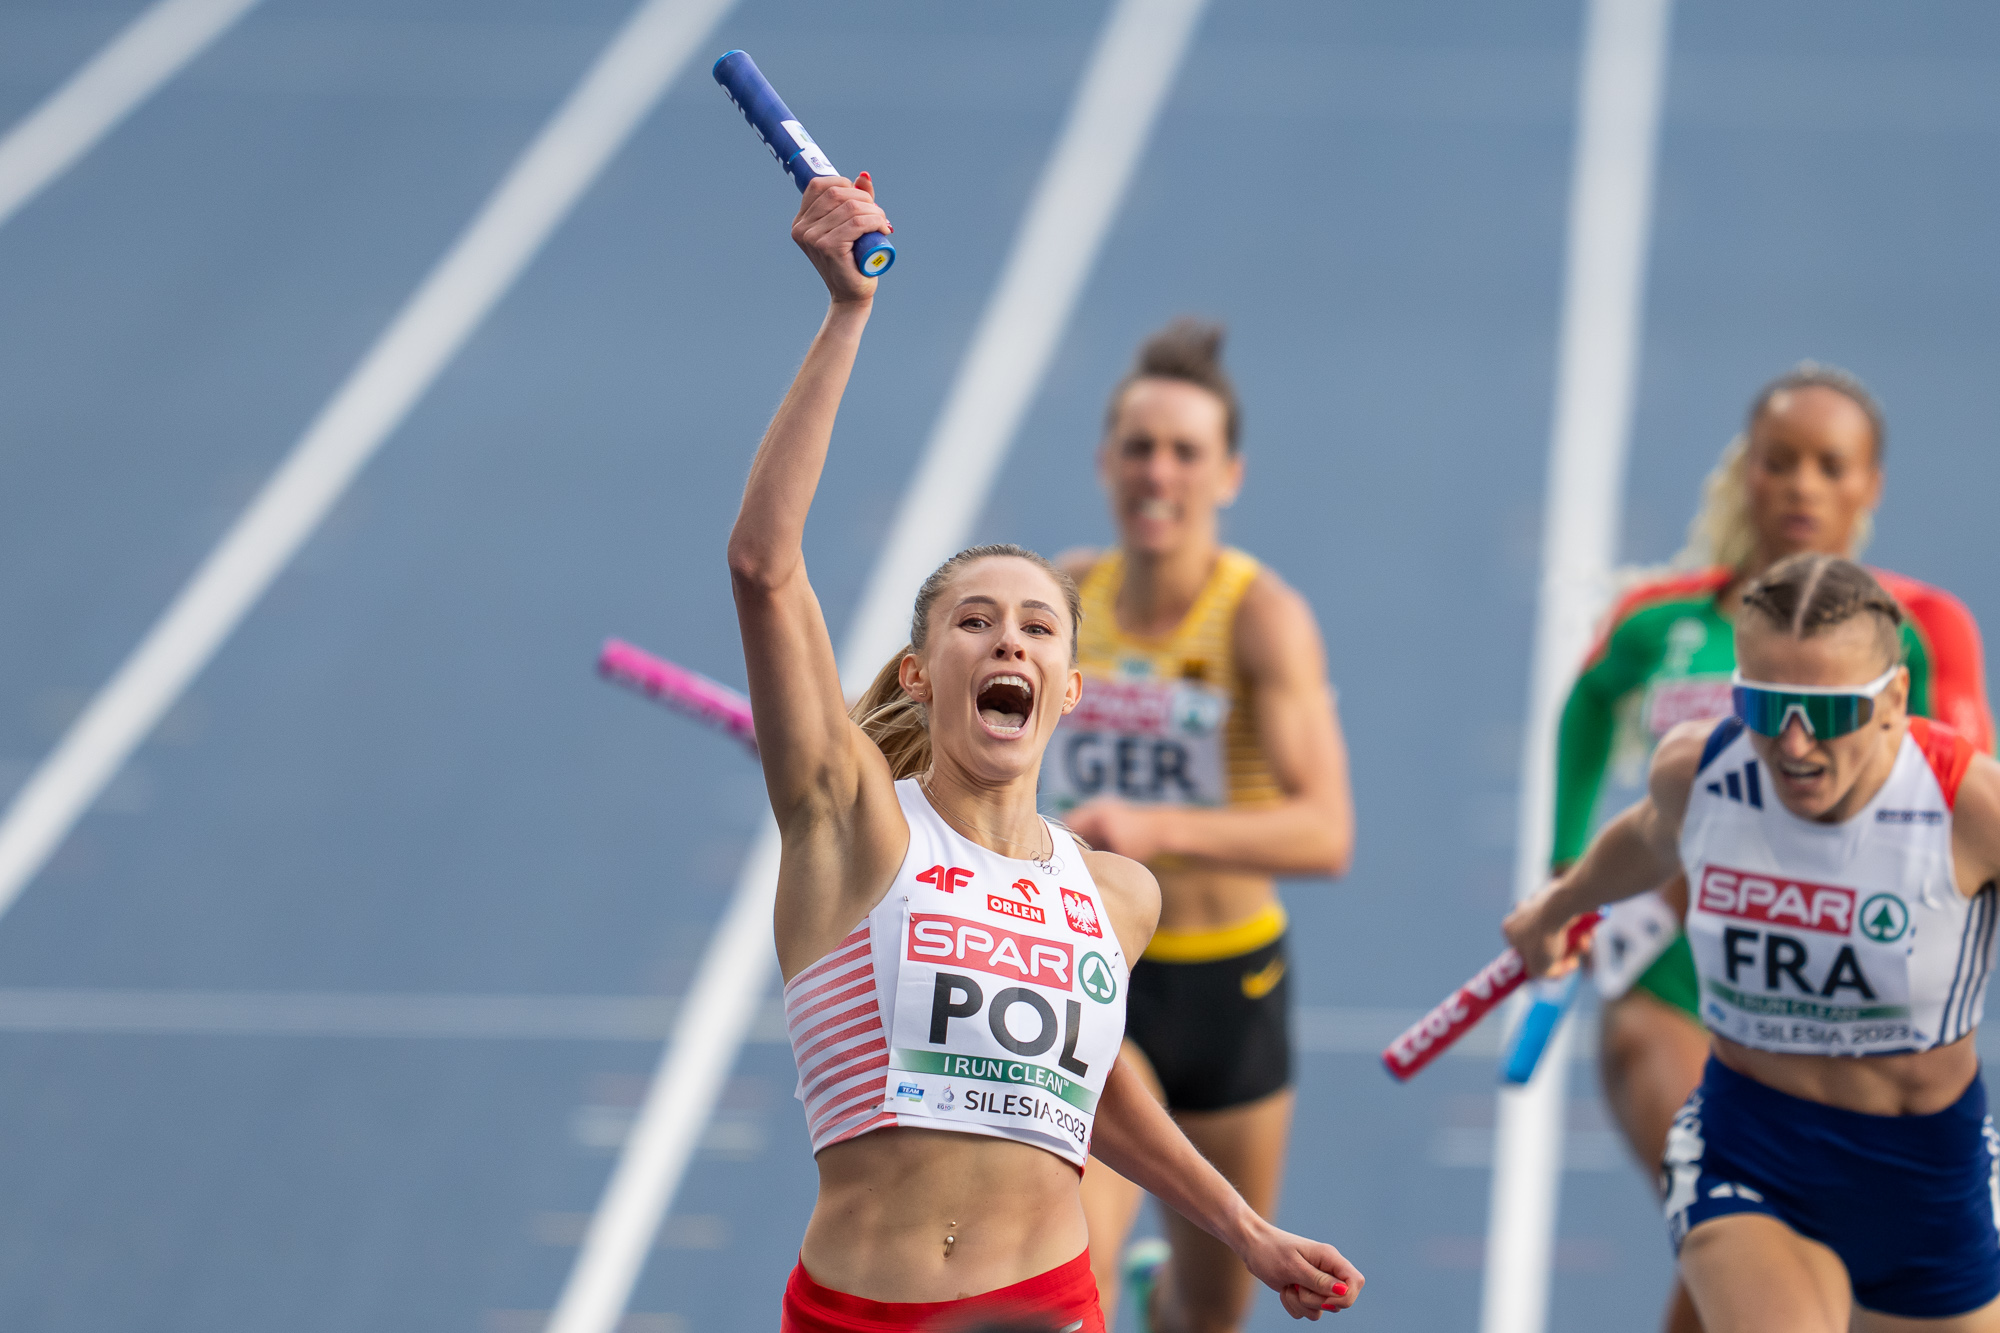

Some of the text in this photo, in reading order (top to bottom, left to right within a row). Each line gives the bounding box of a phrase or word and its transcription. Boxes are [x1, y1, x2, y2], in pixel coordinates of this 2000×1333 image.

[1063, 732, 1195, 799] GER
[916, 864, 975, 894] 4F
[1703, 869, 1851, 931] SPAR
[990, 897, 1043, 922] ORLEN
[913, 920, 1069, 984] SPAR
[1723, 927, 1877, 1001] FRA
[928, 971, 1089, 1078] POL
[1756, 1020, 1911, 1045] SILESIA 2023
[902, 1086, 920, 1095] TEAM
[943, 1055, 950, 1073] I
[954, 1057, 1003, 1079] RUN
[963, 1089, 1087, 1144] SILESIA 2023
